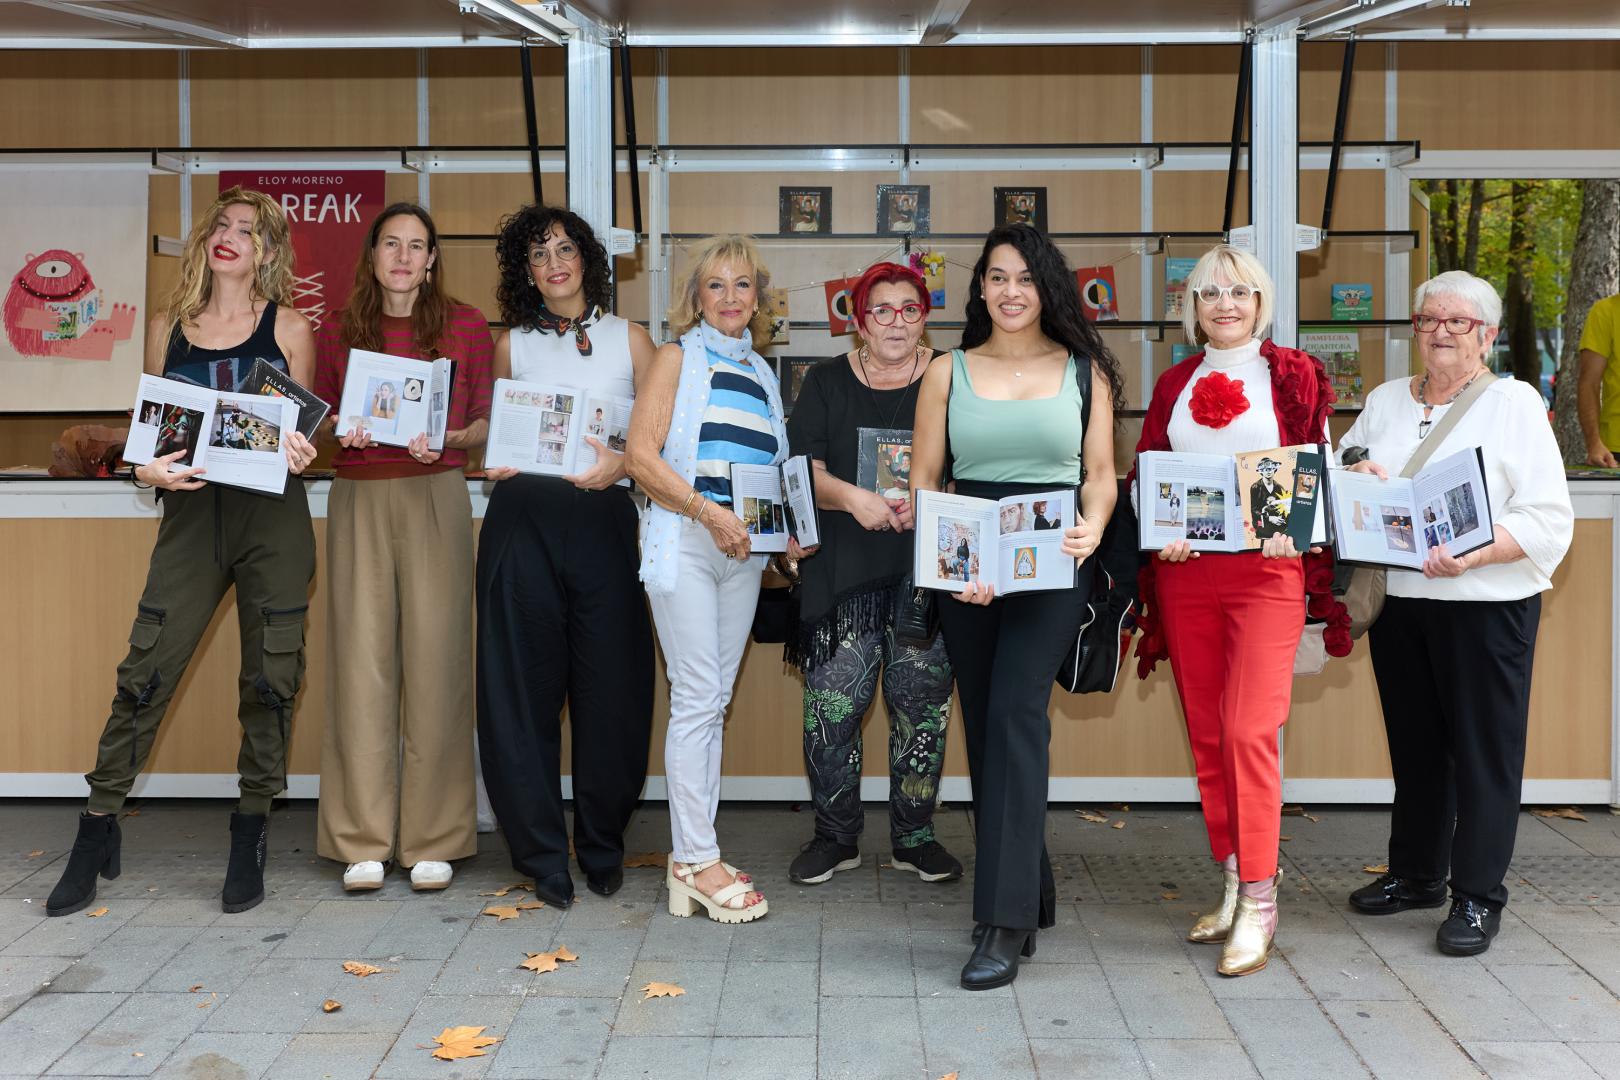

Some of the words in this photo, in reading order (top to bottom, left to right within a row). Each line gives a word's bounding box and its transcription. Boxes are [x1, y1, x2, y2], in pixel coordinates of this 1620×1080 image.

[258, 176, 287, 185] ELOY
[291, 176, 344, 185] MORENO
[266, 193, 362, 224] REAK
[265, 375, 287, 395] ELLAS,
[876, 436, 904, 444] ELLAS,
